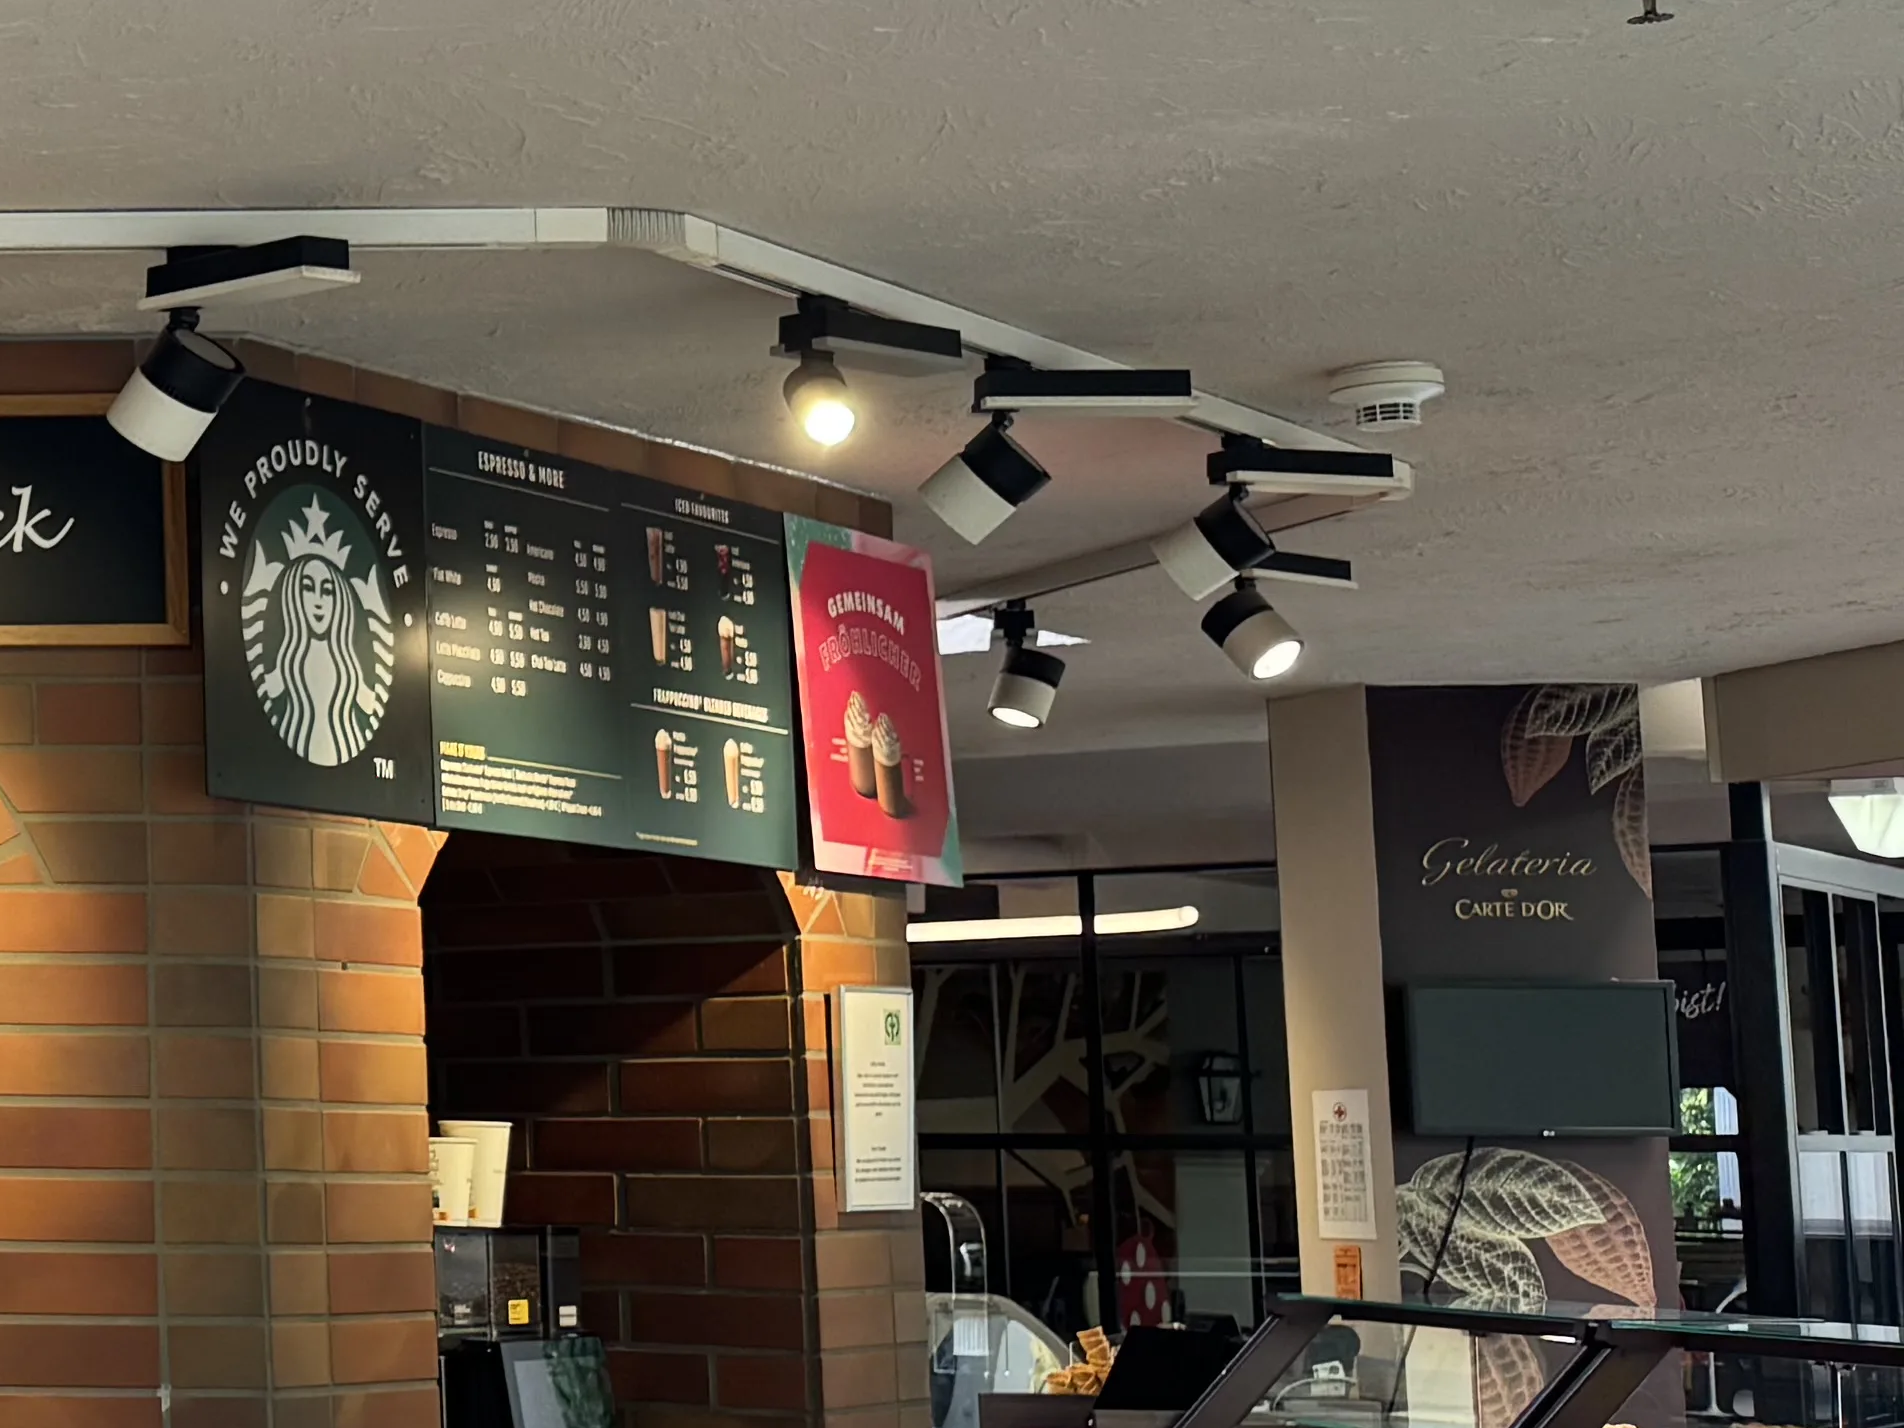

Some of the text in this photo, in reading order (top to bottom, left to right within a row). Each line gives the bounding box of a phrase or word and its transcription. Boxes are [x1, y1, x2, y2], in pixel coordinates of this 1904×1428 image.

[478, 451, 564, 489] ESPRESSO & MORE
[220, 440, 409, 589] WE PROUDLY SERVE
[828, 590, 905, 636] GEMEINSAM
[819, 624, 921, 692] FRÖHLICHER
[374, 758, 394, 779] TM
[1421, 837, 1597, 886] Gelateria
[1455, 898, 1515, 920] CARTE
